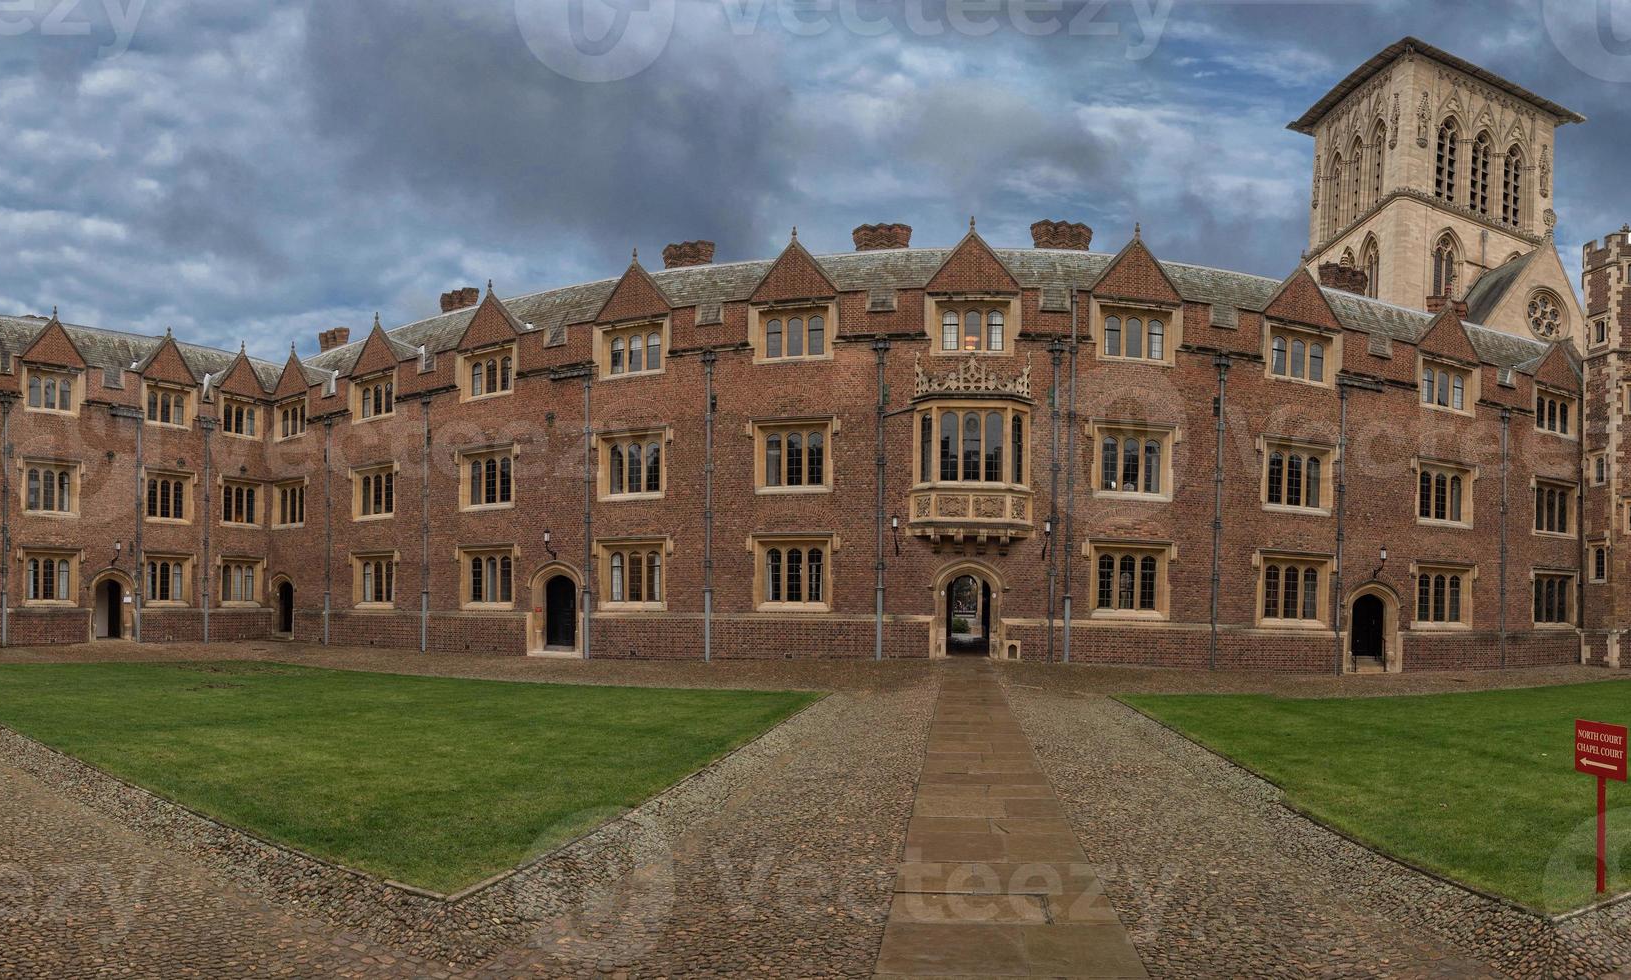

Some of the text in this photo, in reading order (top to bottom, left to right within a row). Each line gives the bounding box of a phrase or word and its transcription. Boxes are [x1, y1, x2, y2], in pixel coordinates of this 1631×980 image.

[1578, 729, 1622, 745] NORTH COURT
[1577, 742, 1624, 759] CHAPEL COURT
